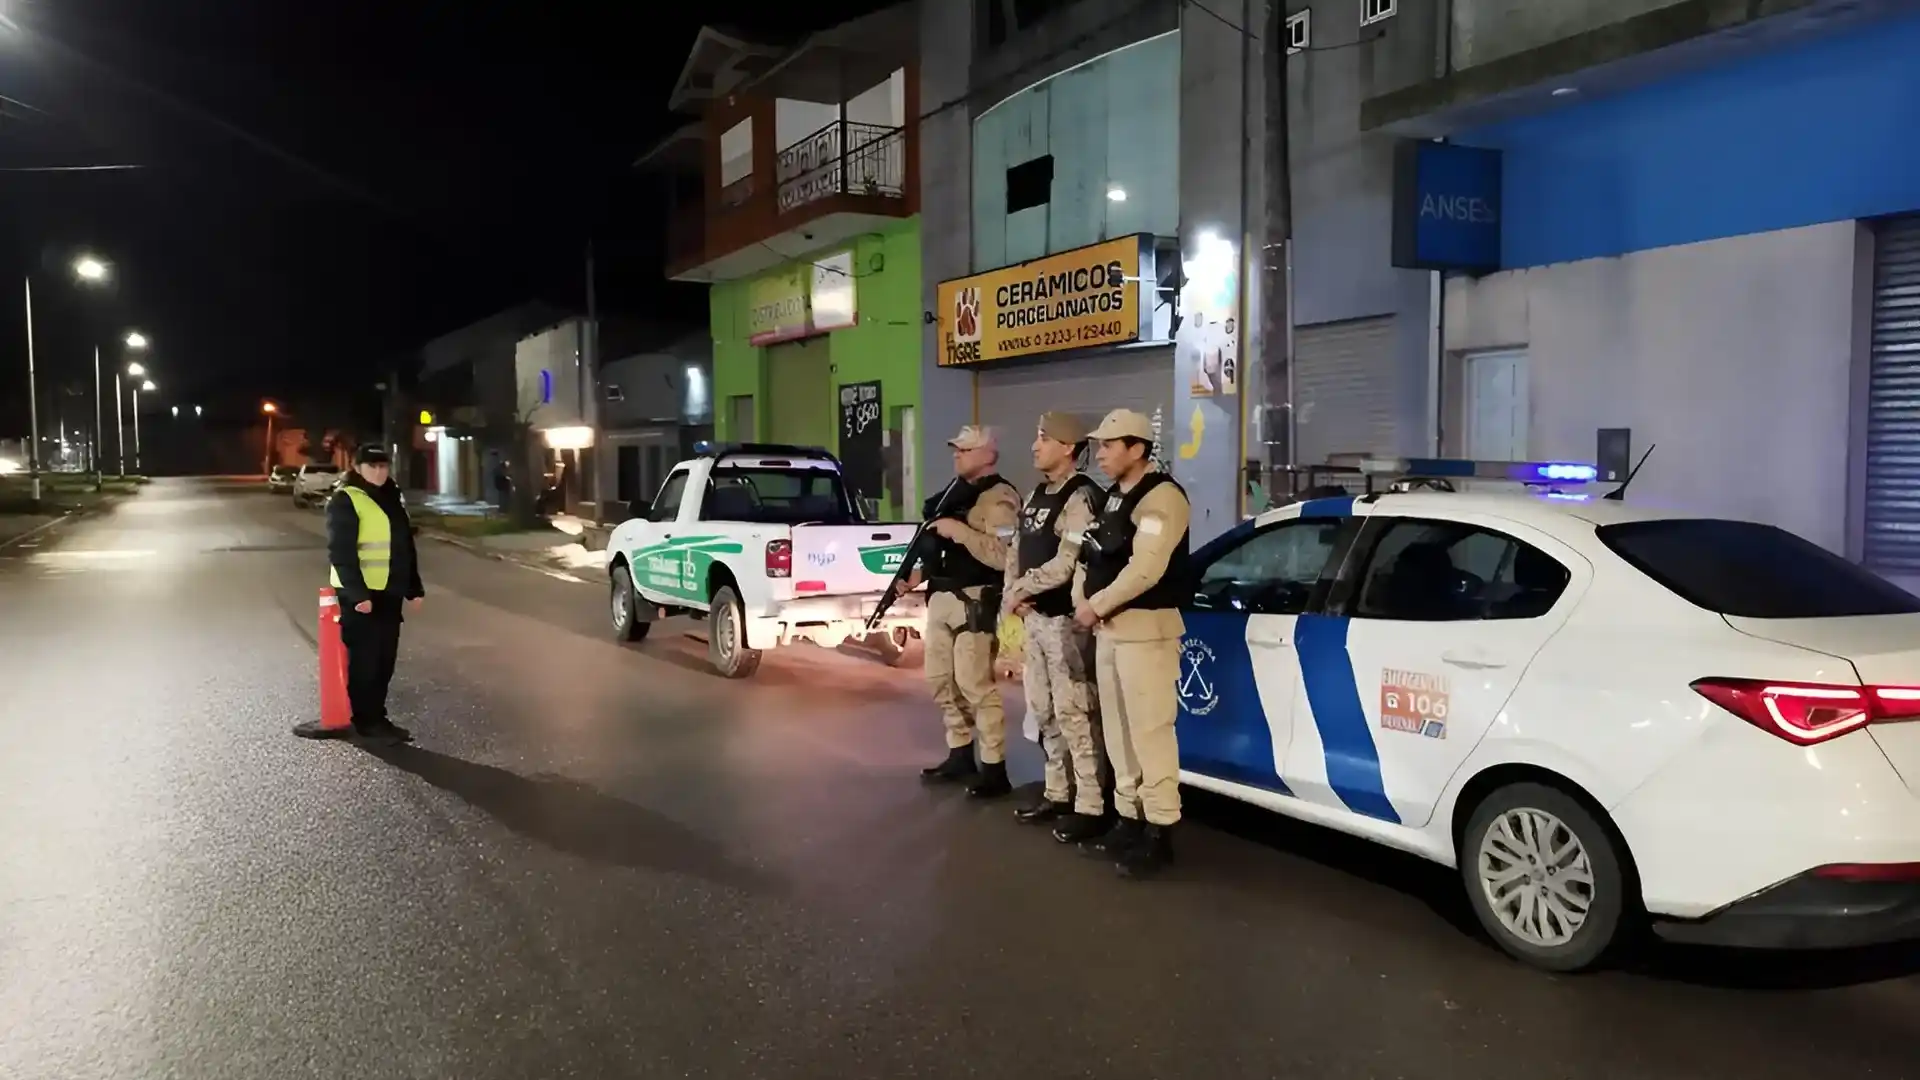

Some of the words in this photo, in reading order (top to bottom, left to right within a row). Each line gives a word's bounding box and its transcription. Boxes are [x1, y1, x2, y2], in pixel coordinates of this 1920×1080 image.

[997, 290, 1123, 329] PORCELANATOS
[946, 340, 981, 364] TIGRE
[1406, 692, 1446, 718] 106
